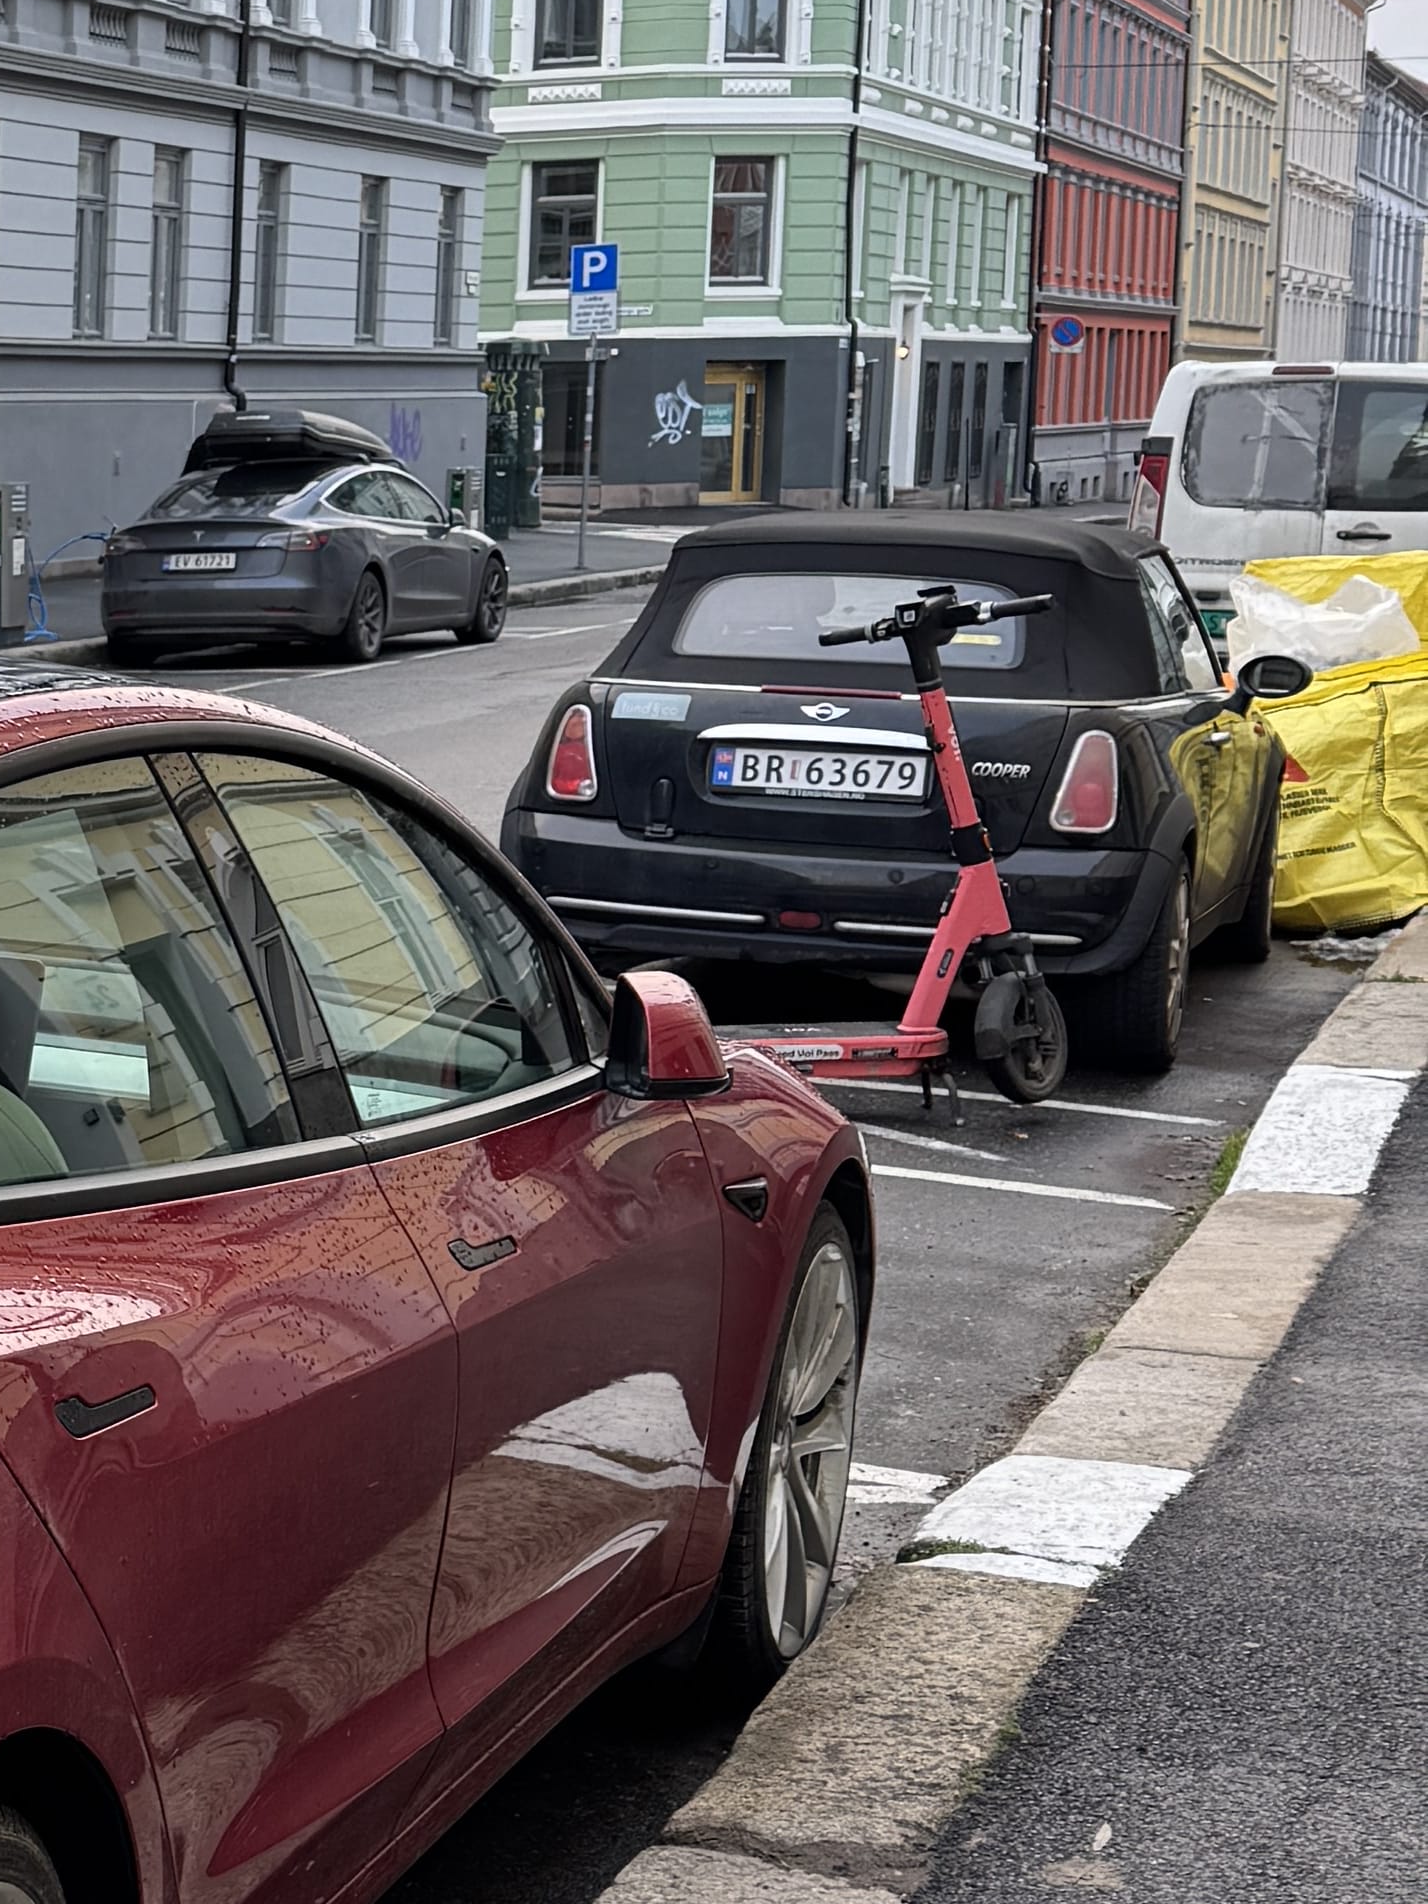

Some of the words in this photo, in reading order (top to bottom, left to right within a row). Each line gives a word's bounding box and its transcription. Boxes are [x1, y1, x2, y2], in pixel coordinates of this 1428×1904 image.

[582, 250, 608, 288] P
[740, 754, 785, 784] BR
[804, 756, 918, 790] 63679
[971, 760, 1033, 780] COOPER
